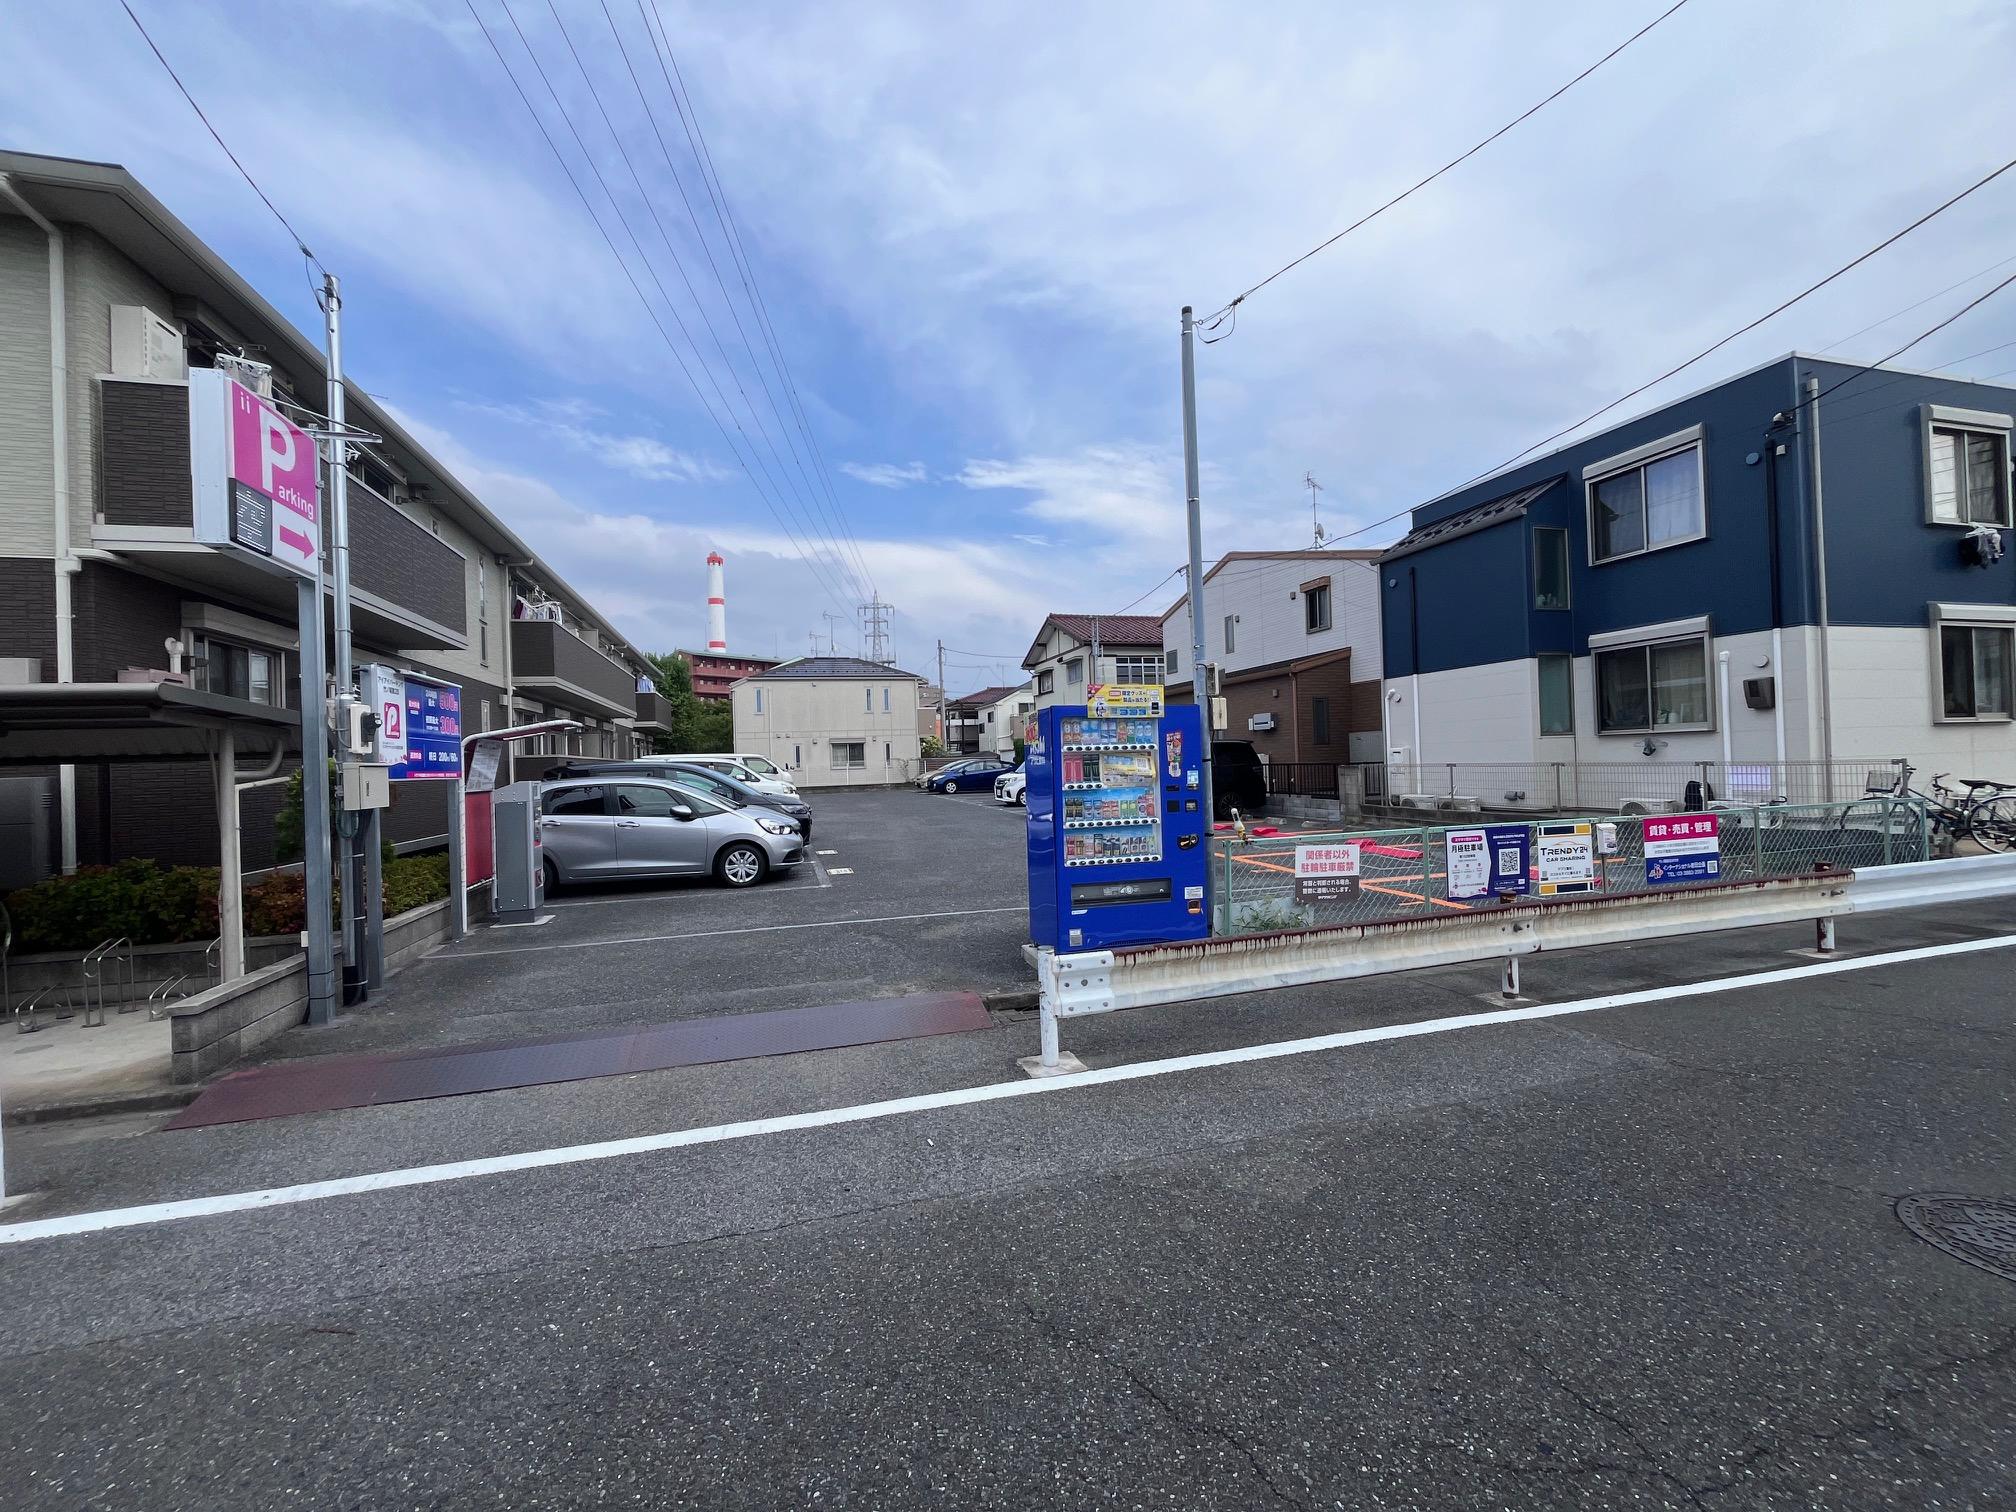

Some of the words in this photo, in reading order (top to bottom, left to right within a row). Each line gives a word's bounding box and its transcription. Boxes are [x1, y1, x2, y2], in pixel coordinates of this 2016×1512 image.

[1649, 821, 1712, 837] 賃貸・売買・管理
[1451, 843, 1483, 853] 月極駐車場
[1306, 849, 1349, 860] 関係者以外
[1301, 862, 1354, 873] 駐輪駐車厳禁
